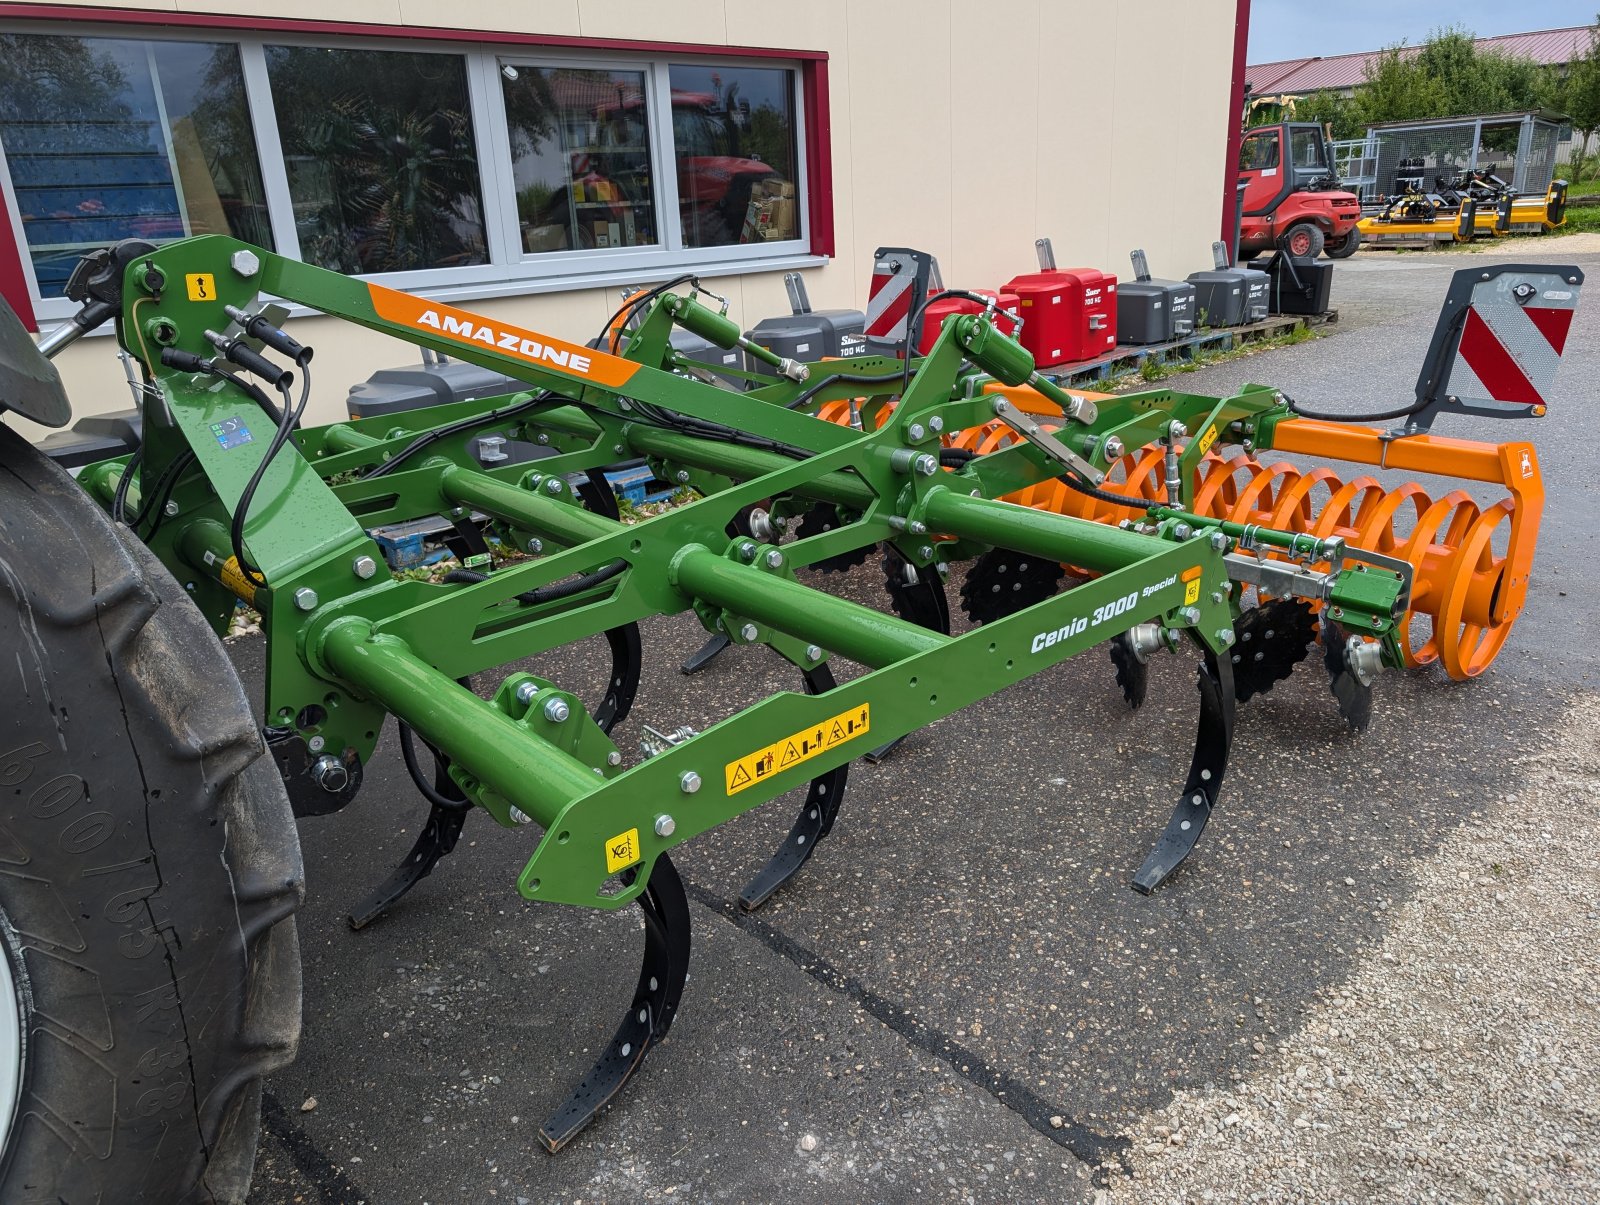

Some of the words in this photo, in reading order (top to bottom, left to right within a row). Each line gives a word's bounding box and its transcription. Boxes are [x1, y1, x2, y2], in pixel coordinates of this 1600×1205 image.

[416, 310, 592, 373] AMAZONE
[840, 347, 854, 357] 700
[855, 345, 866, 353] KG
[1031, 617, 1088, 654] Cenio
[1091, 591, 1139, 627] 3000
[1142, 574, 1177, 597] Special
